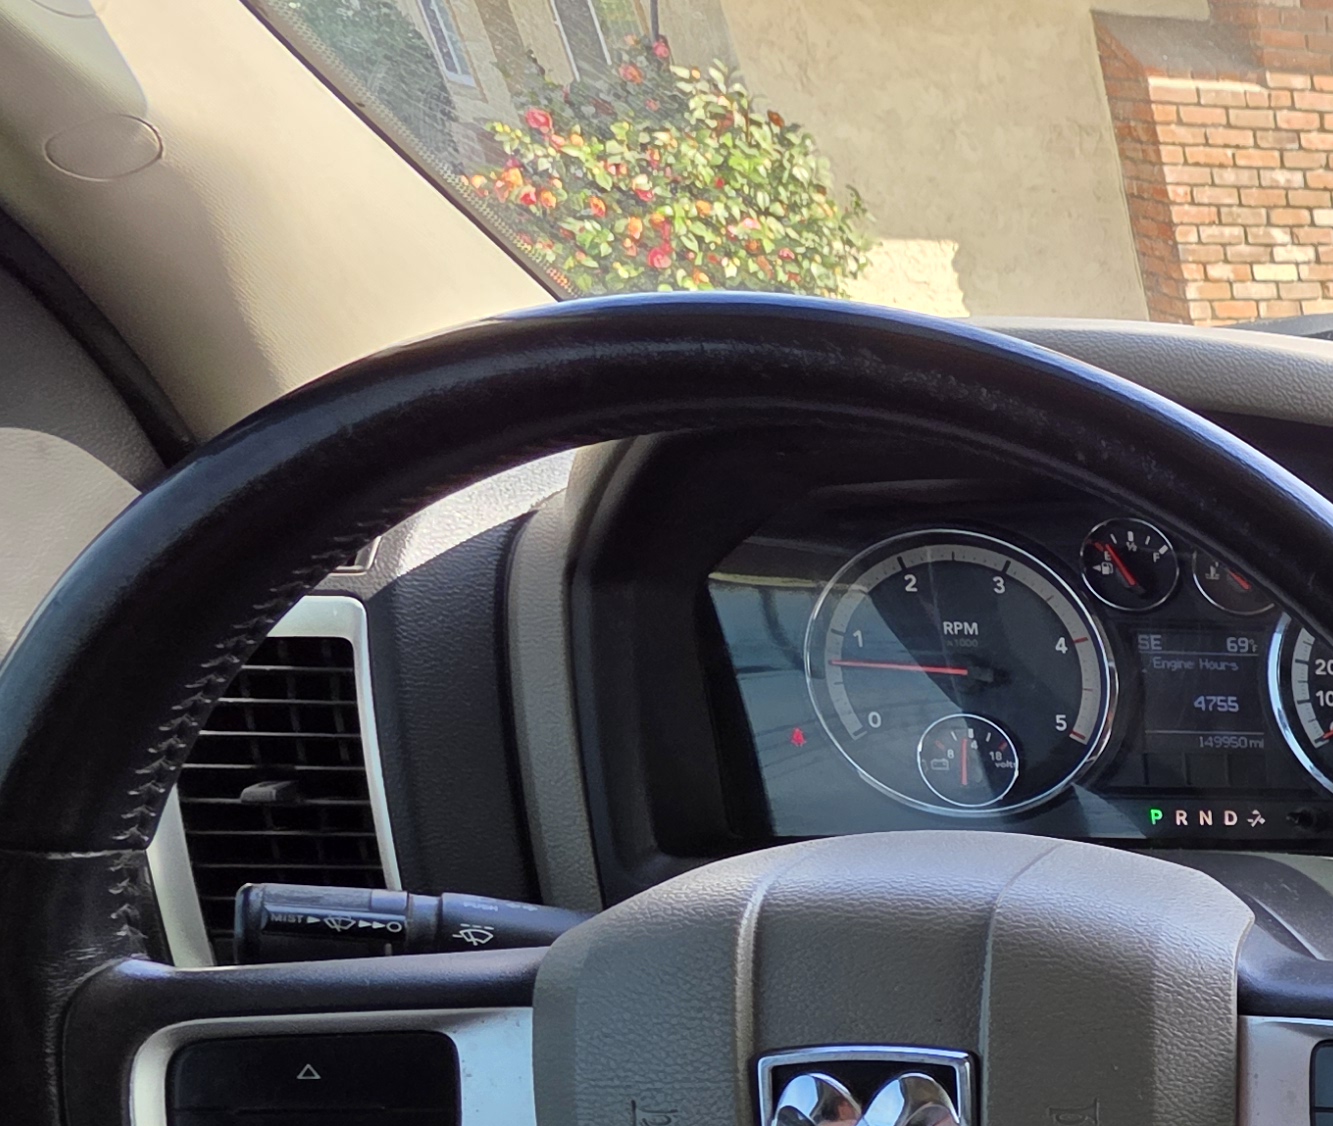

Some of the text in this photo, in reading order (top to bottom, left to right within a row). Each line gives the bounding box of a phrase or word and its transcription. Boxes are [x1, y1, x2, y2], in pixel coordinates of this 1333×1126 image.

[1104, 551, 1111, 561] E
[1153, 552, 1160, 562] F
[904, 574, 918, 592] 2
[993, 576, 1006, 594] 3
[942, 621, 979, 636] RPM
[853, 630, 863, 648] 1
[1055, 637, 1068, 654] 4
[1138, 635, 1163, 650] SE
[1153, 656, 1239, 671] Engine Hours
[1194, 696, 1239, 712] 4755
[868, 711, 882, 729] 0
[1055, 714, 1068, 731] 5
[1199, 736, 1264, 749] 149950 mi
[989, 751, 1002, 761] 18
[1150, 809, 1238, 826] P R N D
[271, 912, 303, 924] MIST
